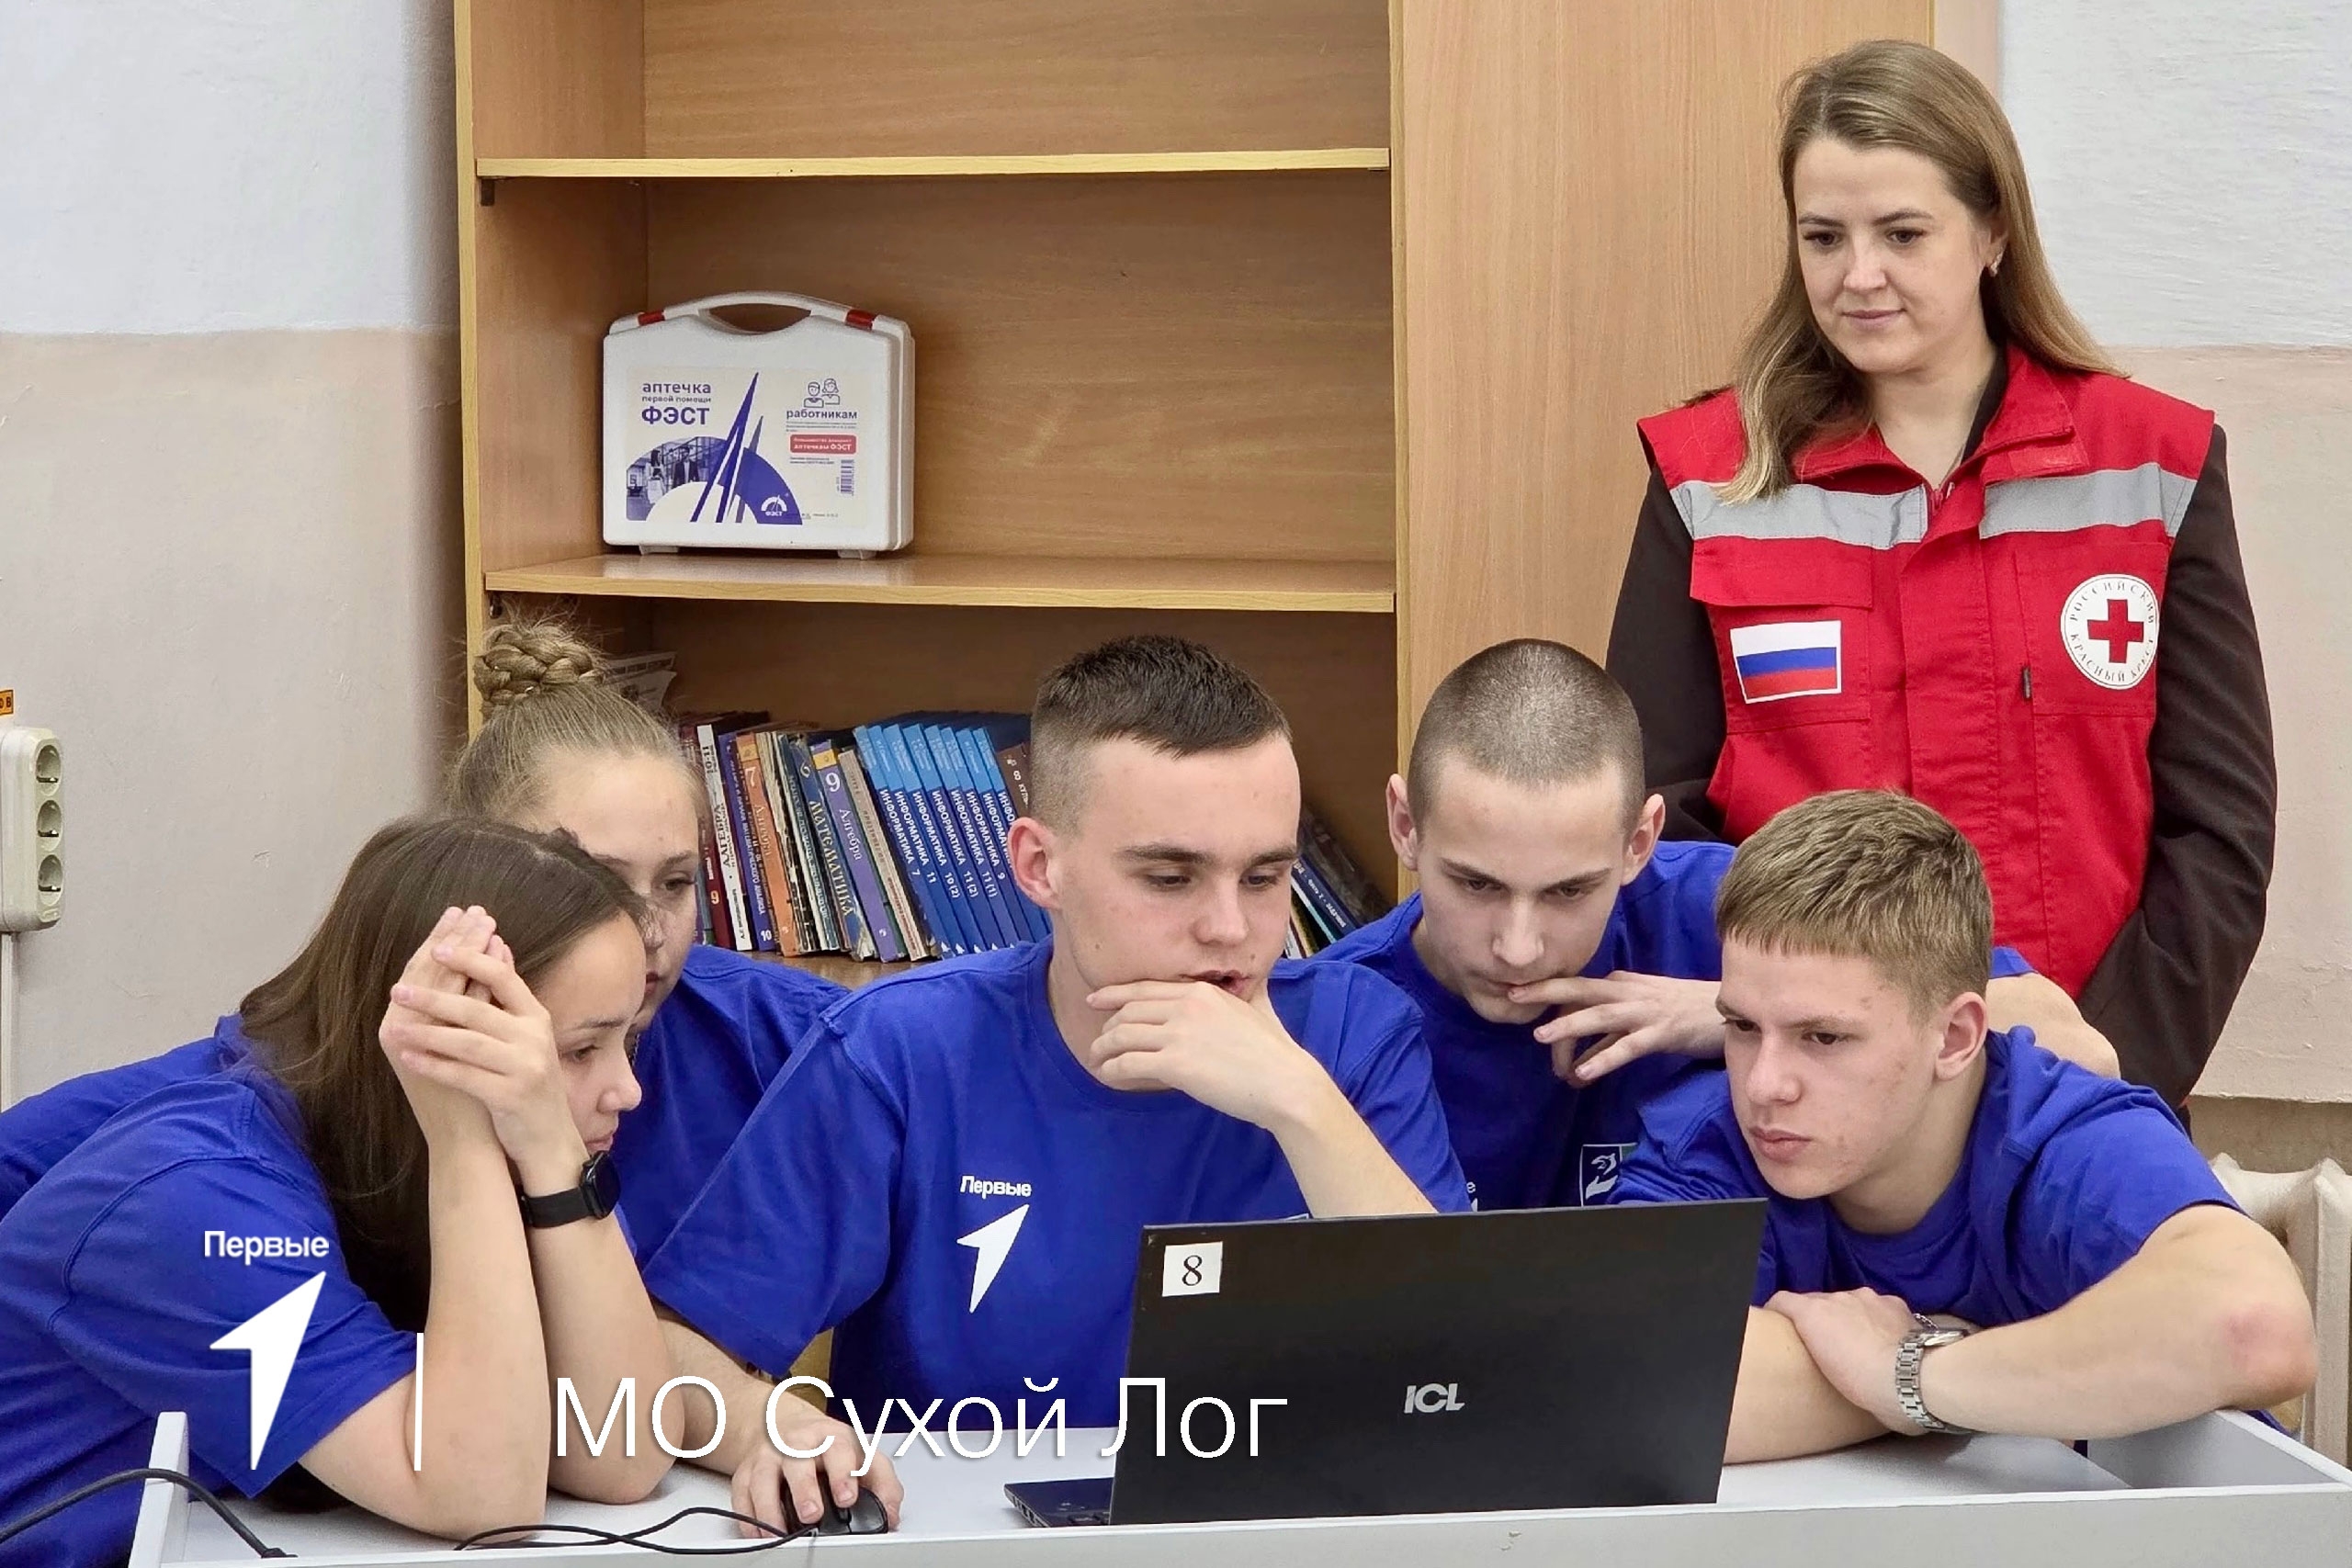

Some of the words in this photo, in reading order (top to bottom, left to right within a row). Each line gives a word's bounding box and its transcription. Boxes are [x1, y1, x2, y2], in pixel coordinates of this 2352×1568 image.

[642, 383, 711, 394] аптечка
[642, 395, 673, 403] первой
[641, 406, 710, 425] ФЭСТ
[786, 409, 858, 420] работникам
[2070, 634, 2125, 682] КРАСНЫЙ
[702, 745, 713, 773] 10-11
[800, 761, 810, 778] 6
[744, 766, 756, 787] 7
[825, 773, 840, 792] 9
[1013, 770, 1022, 781] 8
[714, 804, 731, 868] АЛГЕБРА
[754, 805, 773, 856] Алгебра
[840, 809, 863, 860] Алгебра
[879, 789, 915, 864] ИНФОРМАТИКА
[911, 868, 921, 876] 7
[894, 791, 930, 866] ИНФОРМАТИКА
[926, 872, 936, 884] 11
[912, 791, 947, 866] ИНФОРМАТИКА
[932, 790, 967, 866] ИНФОРМАТИКА
[951, 789, 985, 865] ИНФОРМАТИКА
[982, 871, 990, 883] 11
[966, 791, 1001, 866] ИНФОРМАТИКА
[944, 872, 955, 885] 10
[964, 871, 972, 884] 11
[710, 890, 720, 905] 9
[948, 882, 960, 898] (2)
[967, 885, 978, 897] (2)
[761, 930, 772, 942] 10
[960, 1175, 1033, 1200] Первые
[1182, 1255, 1203, 1286] 8
[1404, 1382, 1465, 1414] ICL
